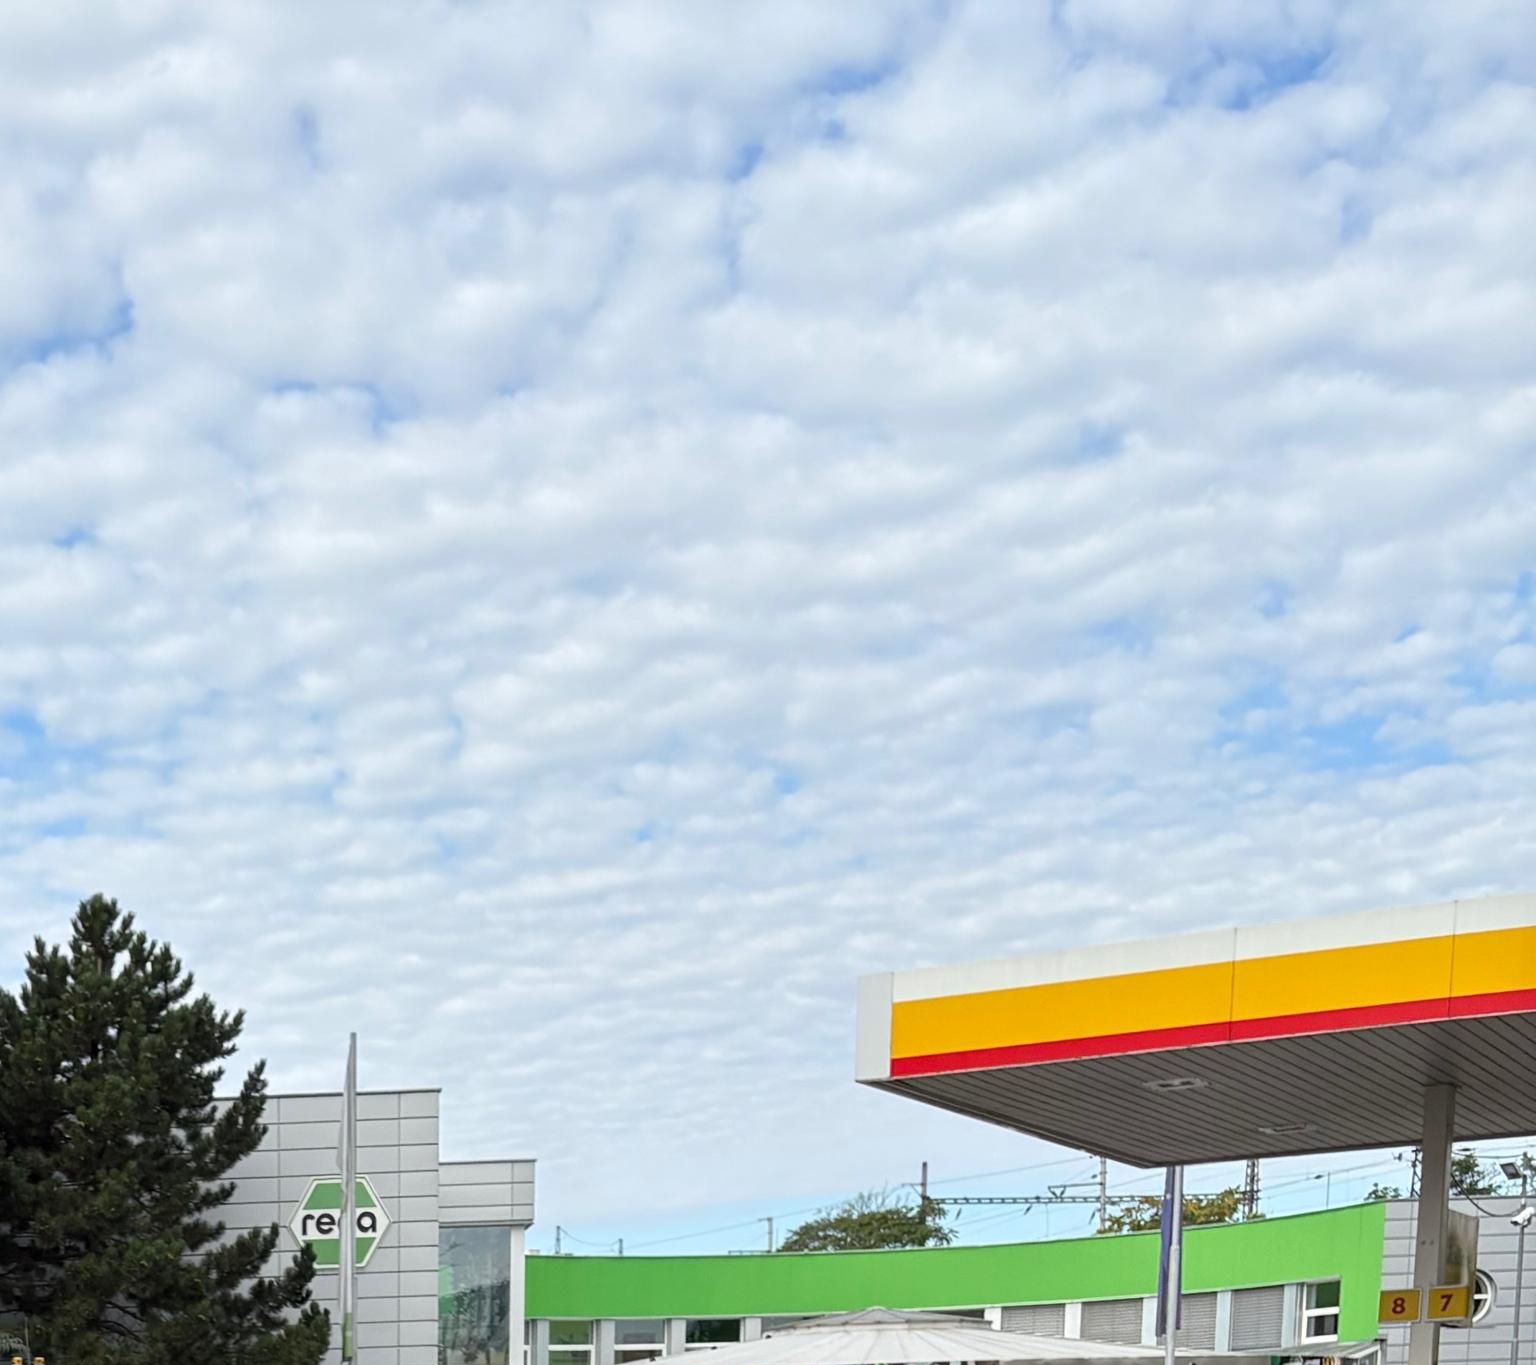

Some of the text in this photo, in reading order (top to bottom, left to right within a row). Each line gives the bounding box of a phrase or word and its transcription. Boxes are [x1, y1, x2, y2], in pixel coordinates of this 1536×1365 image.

[301, 1211, 377, 1235] rea
[1391, 1297, 1406, 1315] 8
[1440, 1294, 1453, 1312] 7
